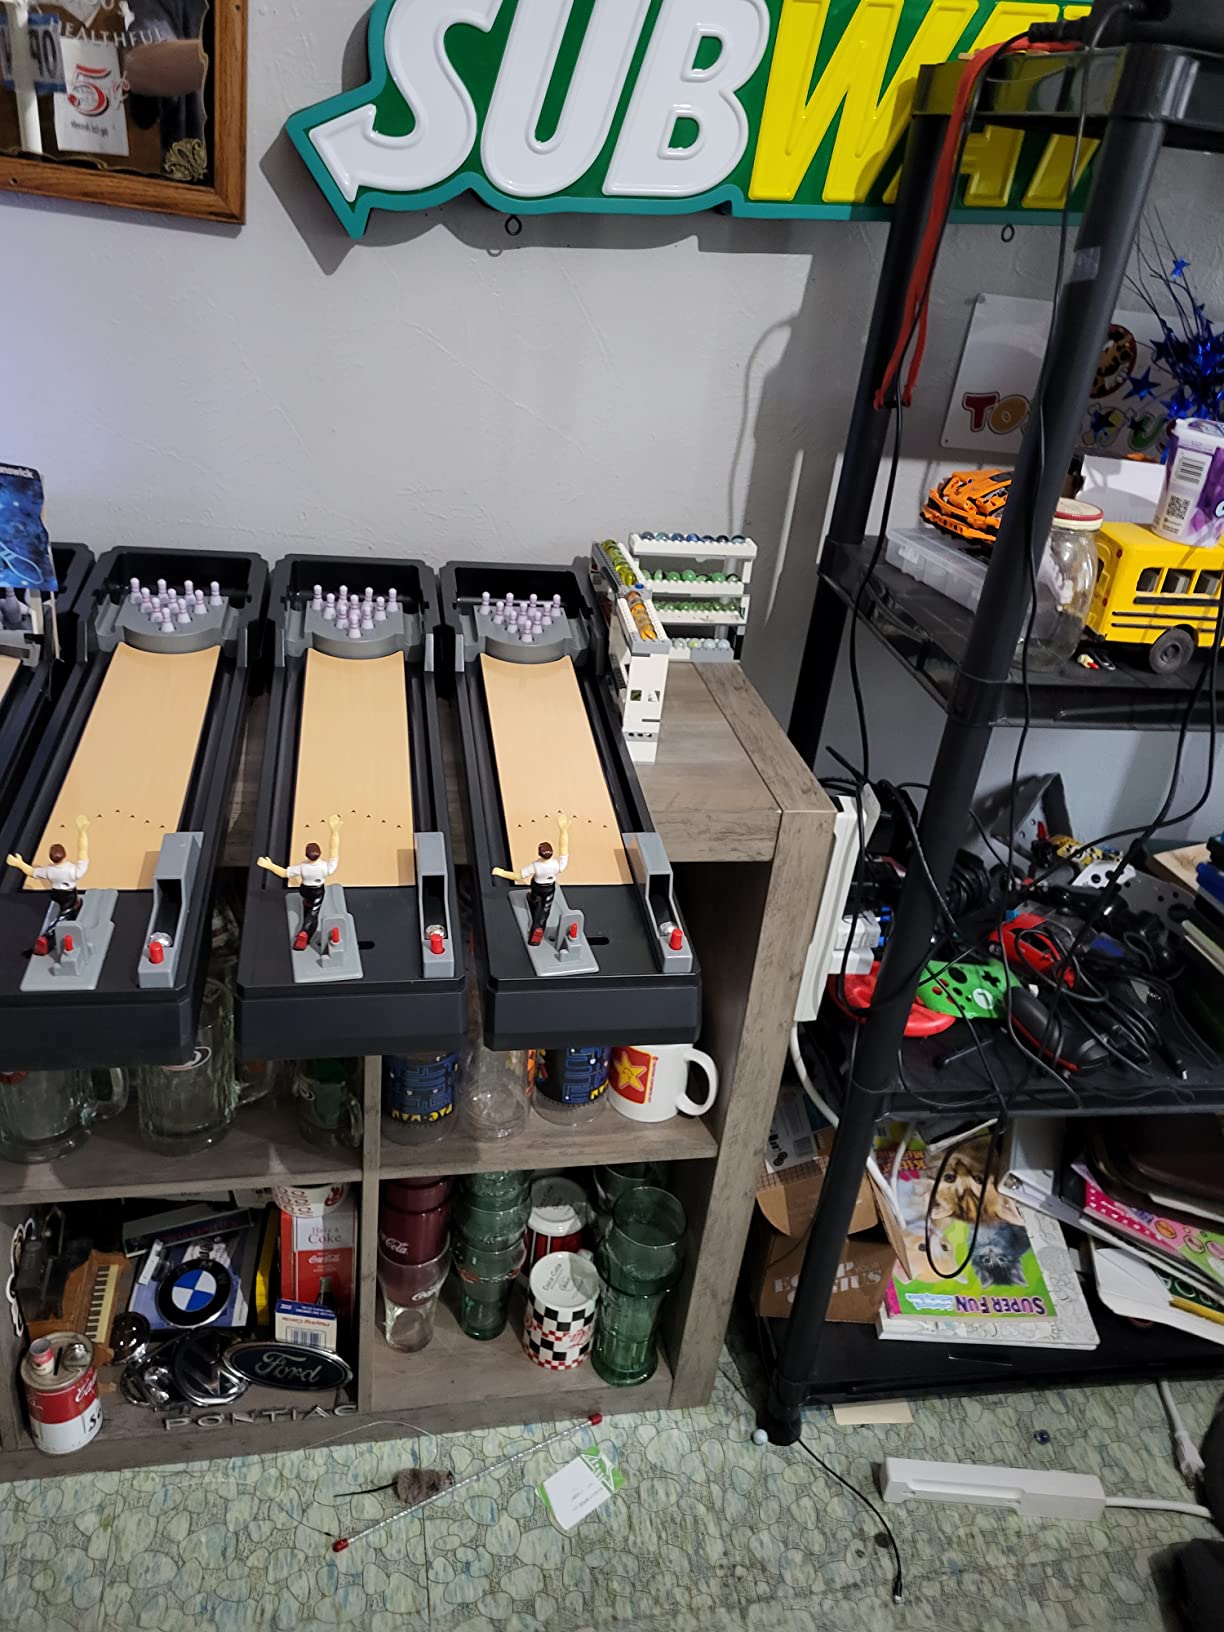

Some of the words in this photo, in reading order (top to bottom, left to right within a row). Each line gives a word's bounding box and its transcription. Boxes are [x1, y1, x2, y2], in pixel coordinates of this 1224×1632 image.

[308, 1231, 342, 1244] Coke
[955, 1295, 991, 1314] FUN
[992, 1296, 1047, 1315] SUPER
[254, 1351, 322, 1382] Ford
[163, 1404, 357, 1431] PONTIAC
